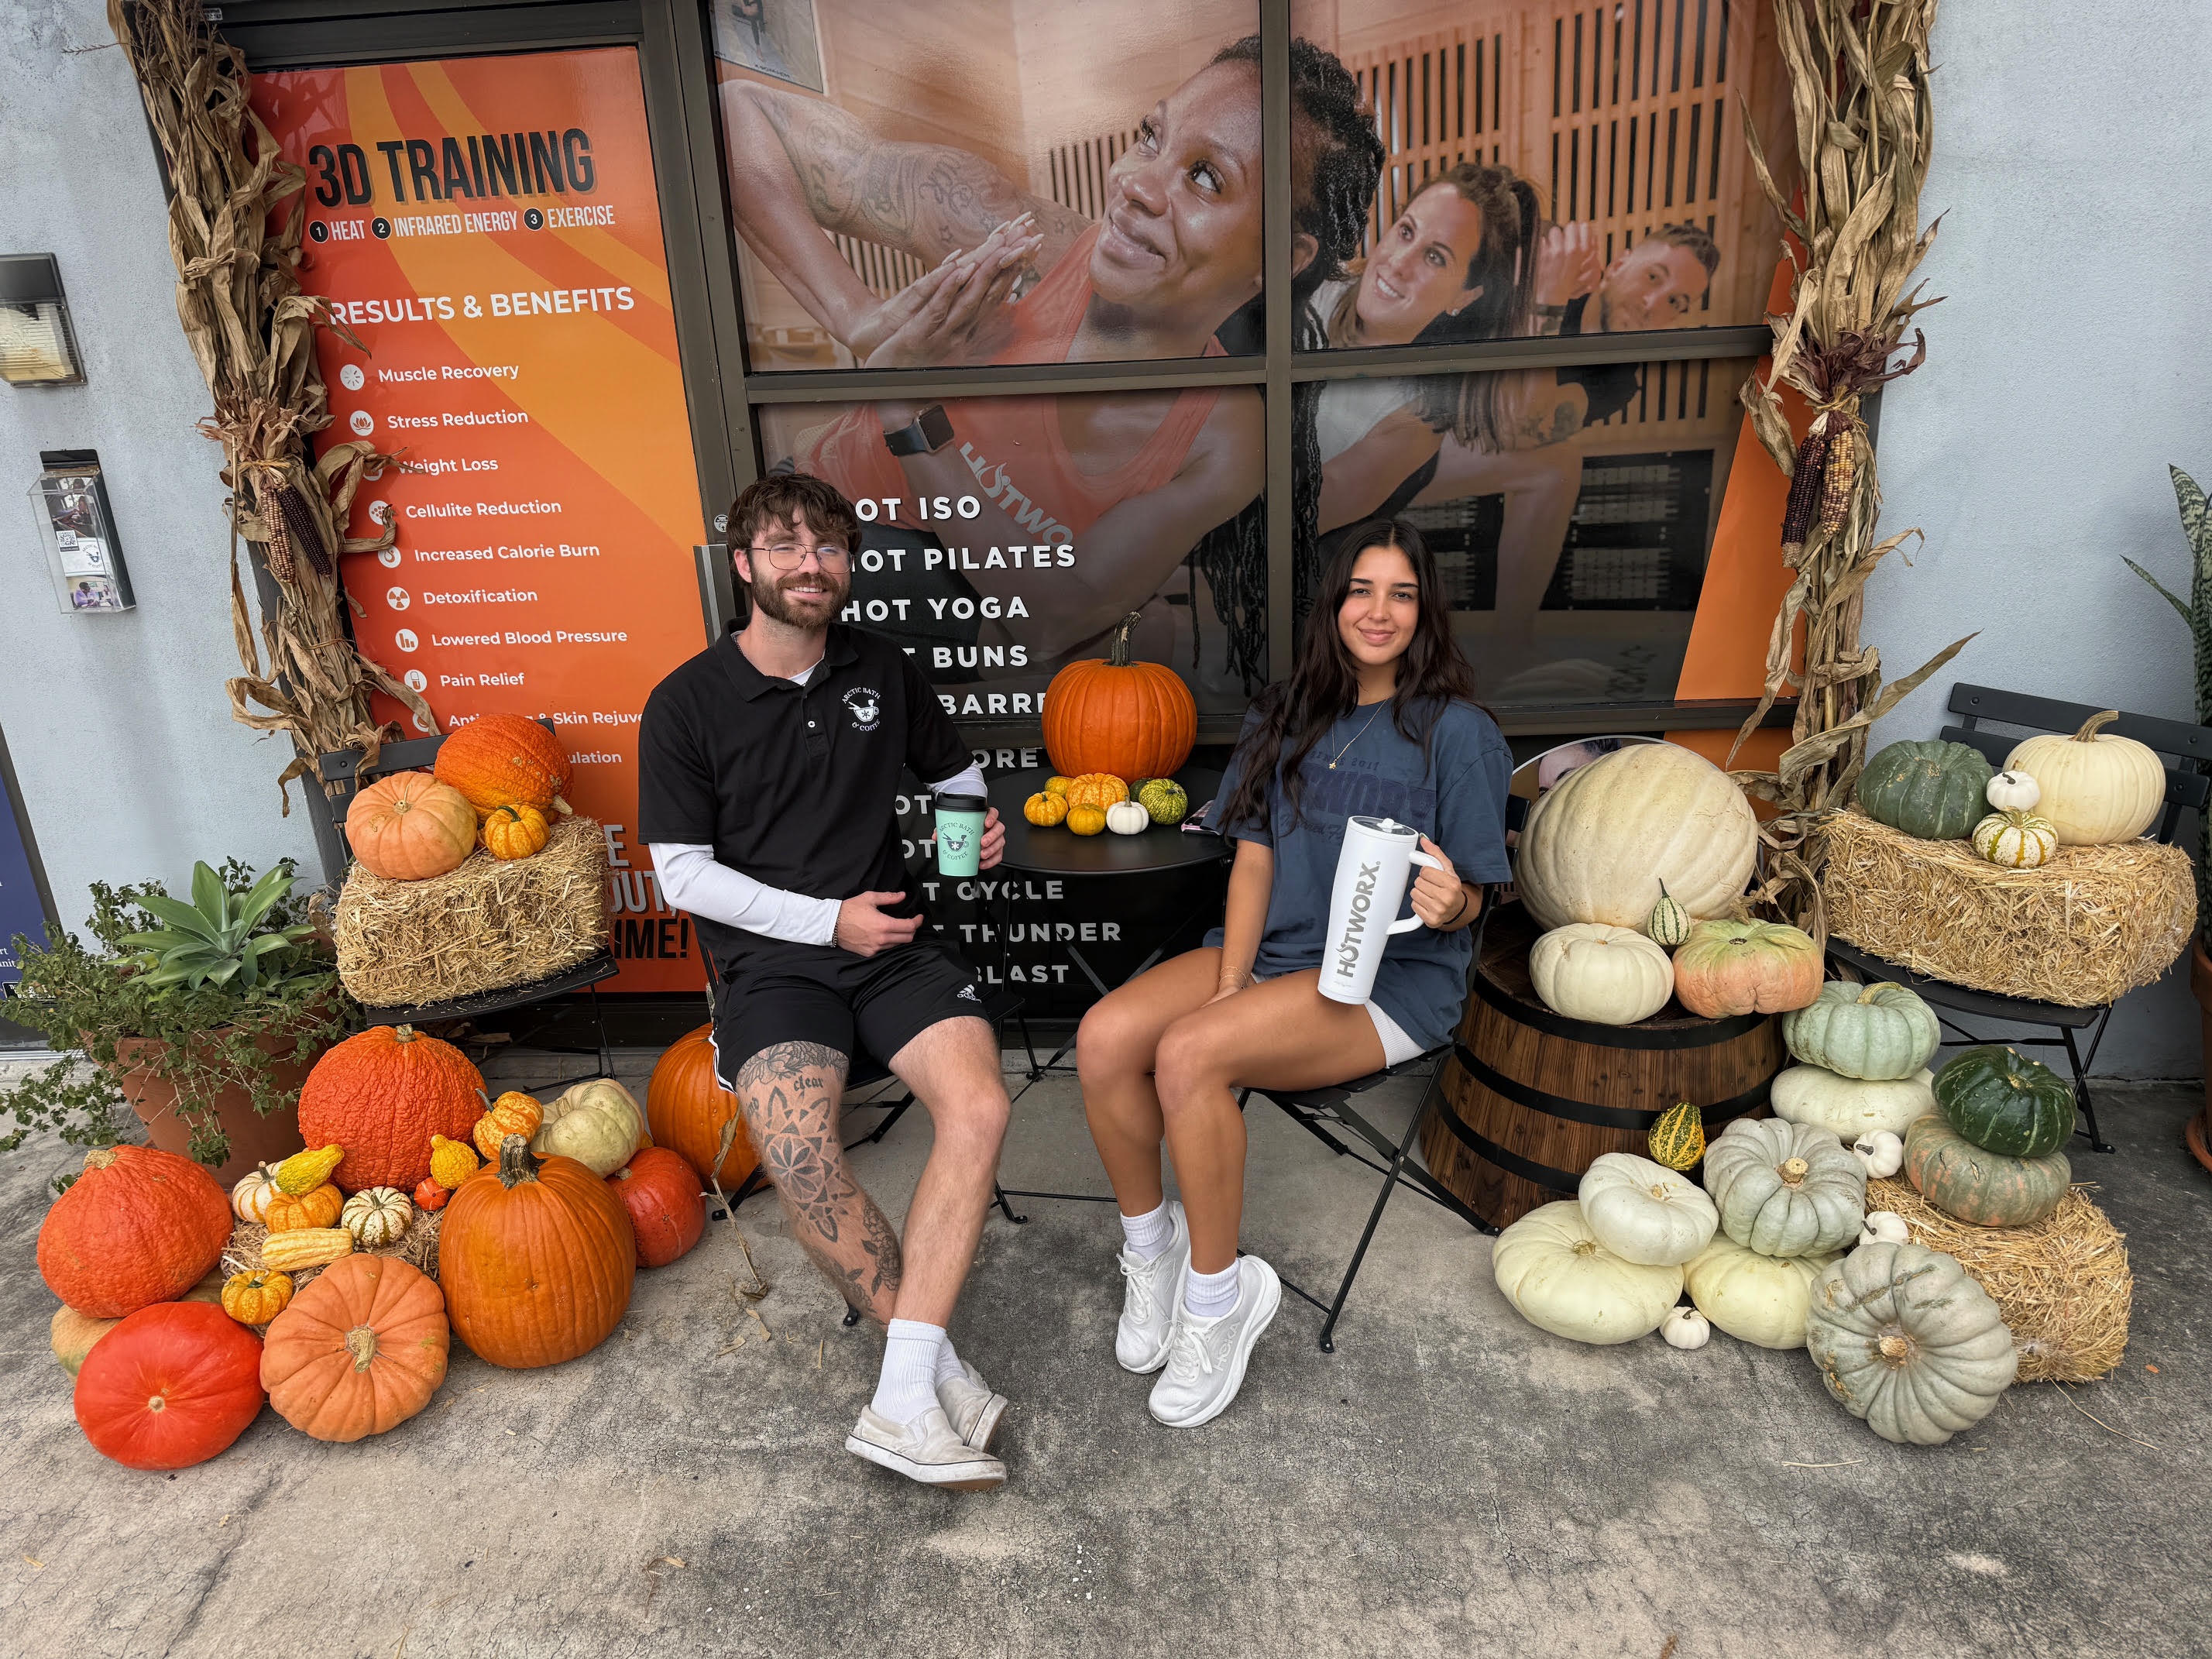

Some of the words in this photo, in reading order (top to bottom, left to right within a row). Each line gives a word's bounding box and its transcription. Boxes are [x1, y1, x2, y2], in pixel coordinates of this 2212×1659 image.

[309, 143, 373, 208] 3D
[376, 129, 593, 201] TRAINING
[331, 220, 364, 240] HEAT
[394, 215, 462, 236] INFRARED
[465, 211, 517, 232] ENERGY
[548, 205, 615, 228] EXERCISE
[330, 297, 455, 325] RESULTS
[464, 296, 483, 318] &
[490, 287, 634, 316] BENEFITS
[379, 367, 435, 382] Muscle
[441, 366, 518, 380] Recovery
[388, 416, 438, 428] Stress
[443, 410, 528, 426] Reduction
[400, 459, 458, 476] Weight
[462, 459, 498, 471] Loss
[960, 441, 1073, 546] HOTWO
[407, 503, 472, 517] Cellulite
[477, 500, 562, 515] Reduction
[856, 499, 901, 521] OT
[919, 496, 980, 519] ISO
[415, 547, 493, 561] Increased
[498, 544, 555, 558] Calorie
[559, 544, 599, 556] Burn
[852, 550, 905, 572] OT
[924, 544, 1074, 570] PILATES
[424, 589, 538, 604] Detoxification
[841, 599, 910, 621] HOT
[927, 596, 1029, 619] YOGA
[432, 632, 500, 646] Lowered
[505, 631, 551, 644] Blood
[556, 631, 627, 642] Pressure
[933, 645, 1027, 668] BUNS
[441, 674, 475, 686] Pain
[479, 672, 524, 685] Relief
[842, 687, 861, 704] ARCTIC
[863, 687, 881, 700] BATH
[553, 712, 588, 724] Skin
[971, 748, 1039, 769] ORE
[895, 795, 932, 815] OT
[939, 822, 958, 832] ARCTIC
[959, 823, 975, 836] BATH
[902, 840, 936, 859] OT
[957, 881, 1063, 900] CYCLE
[614, 919, 689, 960] IME!
[960, 922, 1121, 943] THUNDER
[976, 965, 1068, 984] LAST
